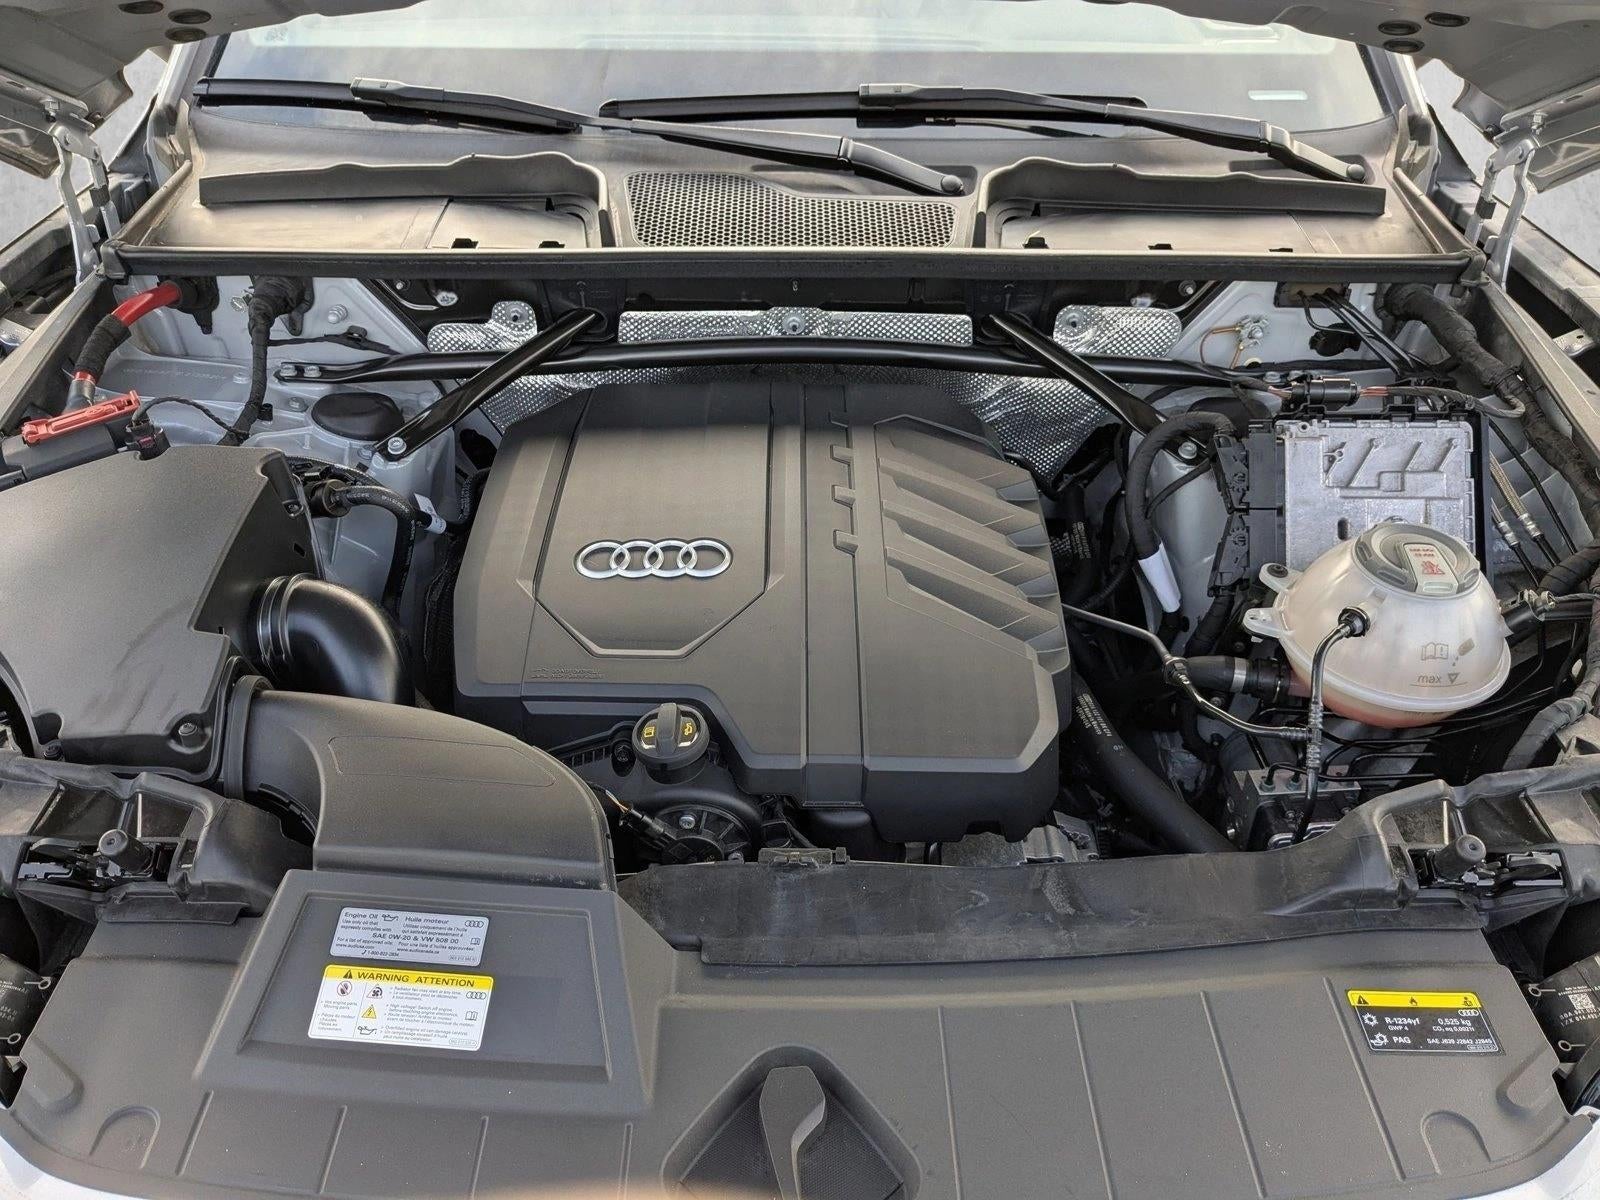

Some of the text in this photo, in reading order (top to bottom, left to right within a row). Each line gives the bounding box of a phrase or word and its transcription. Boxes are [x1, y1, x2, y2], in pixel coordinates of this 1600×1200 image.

[1417, 674, 1442, 684] max
[356, 972, 475, 988] WARNING ATTENTION
[1385, 1016, 1420, 1026] R-1234yf
[1460, 1018, 1471, 1026] kg
[1392, 1036, 1411, 1044] PAG
